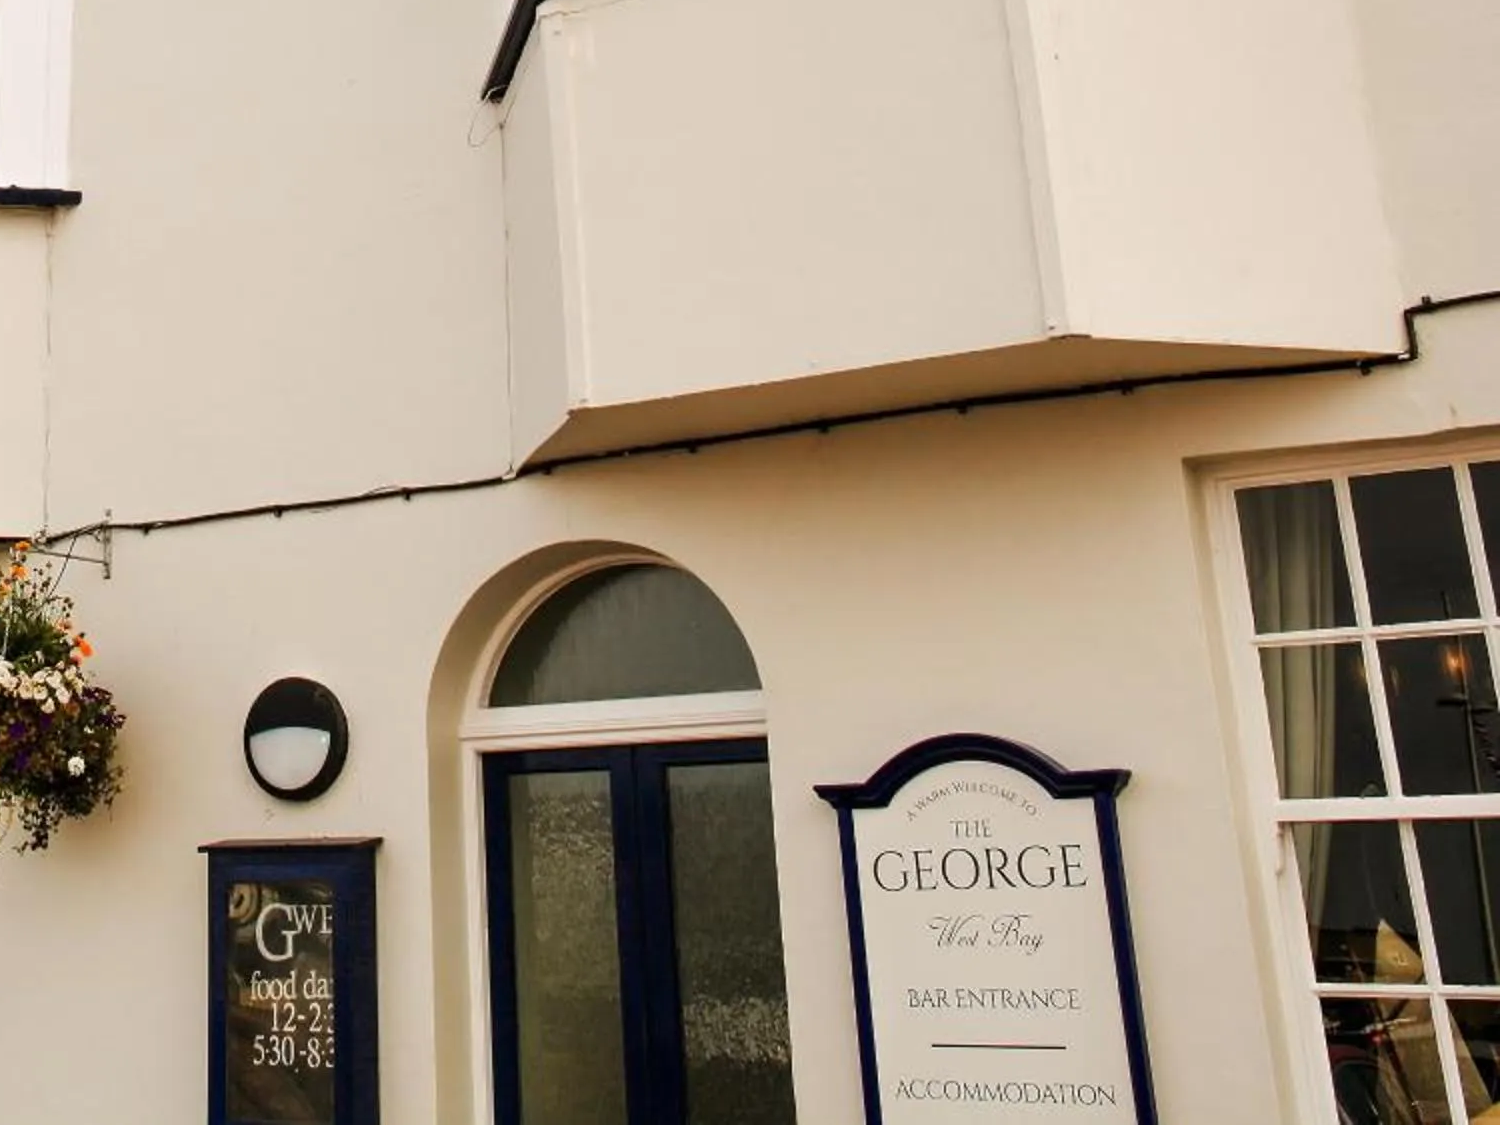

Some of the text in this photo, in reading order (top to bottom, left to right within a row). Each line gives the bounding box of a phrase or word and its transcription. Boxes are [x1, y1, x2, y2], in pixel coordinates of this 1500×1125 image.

[1019, 797, 1039, 817] TO
[949, 818, 993, 839] THE
[872, 843, 1088, 893] GEORGE
[927, 913, 1045, 956] West Bay
[250, 970, 297, 1000] food
[907, 988, 1082, 1011] BAR ENTRANCE
[894, 1078, 1119, 1107] ACCOMMODATION
